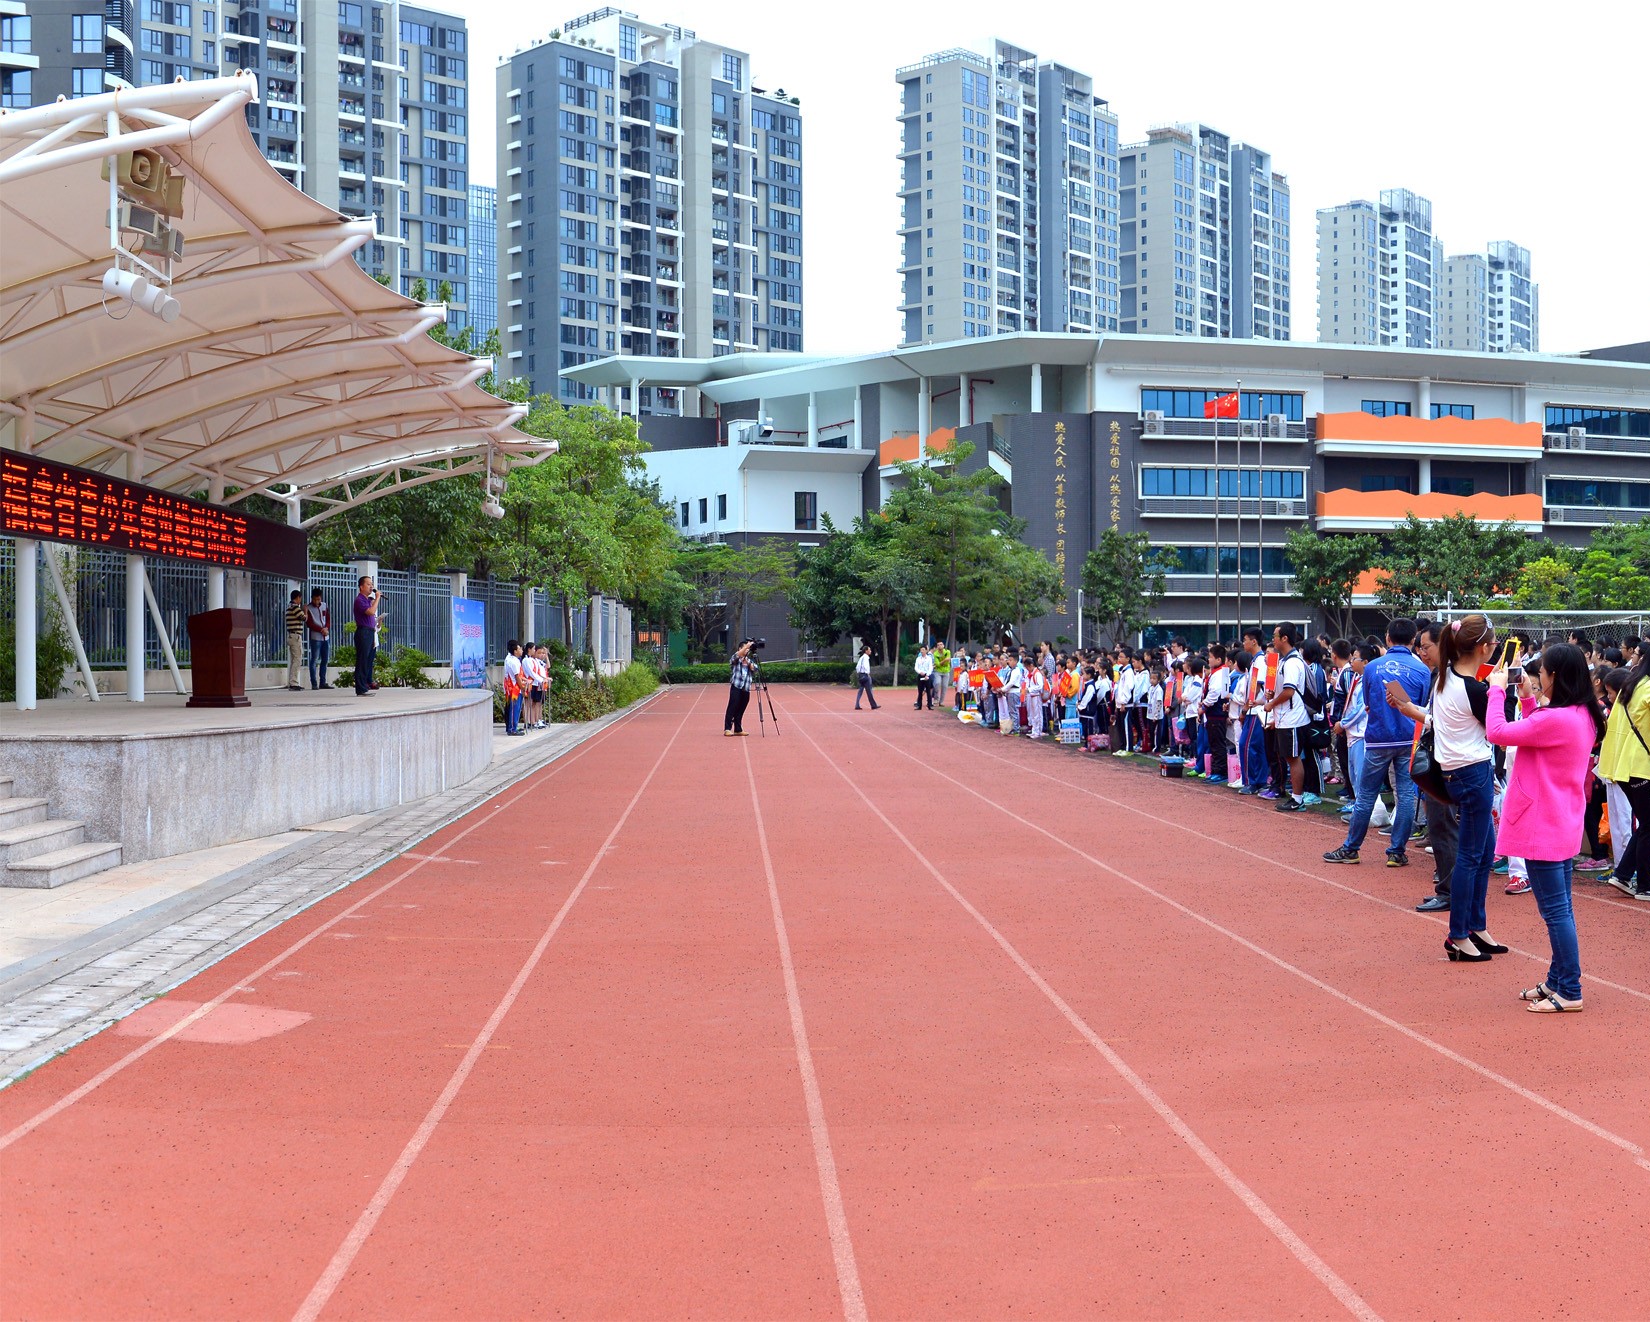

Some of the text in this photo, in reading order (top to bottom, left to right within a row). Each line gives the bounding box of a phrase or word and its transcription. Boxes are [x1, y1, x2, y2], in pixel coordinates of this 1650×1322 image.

[1054, 421, 1067, 468] 热爱人民
[1109, 420, 1121, 468] 热爱祖国
